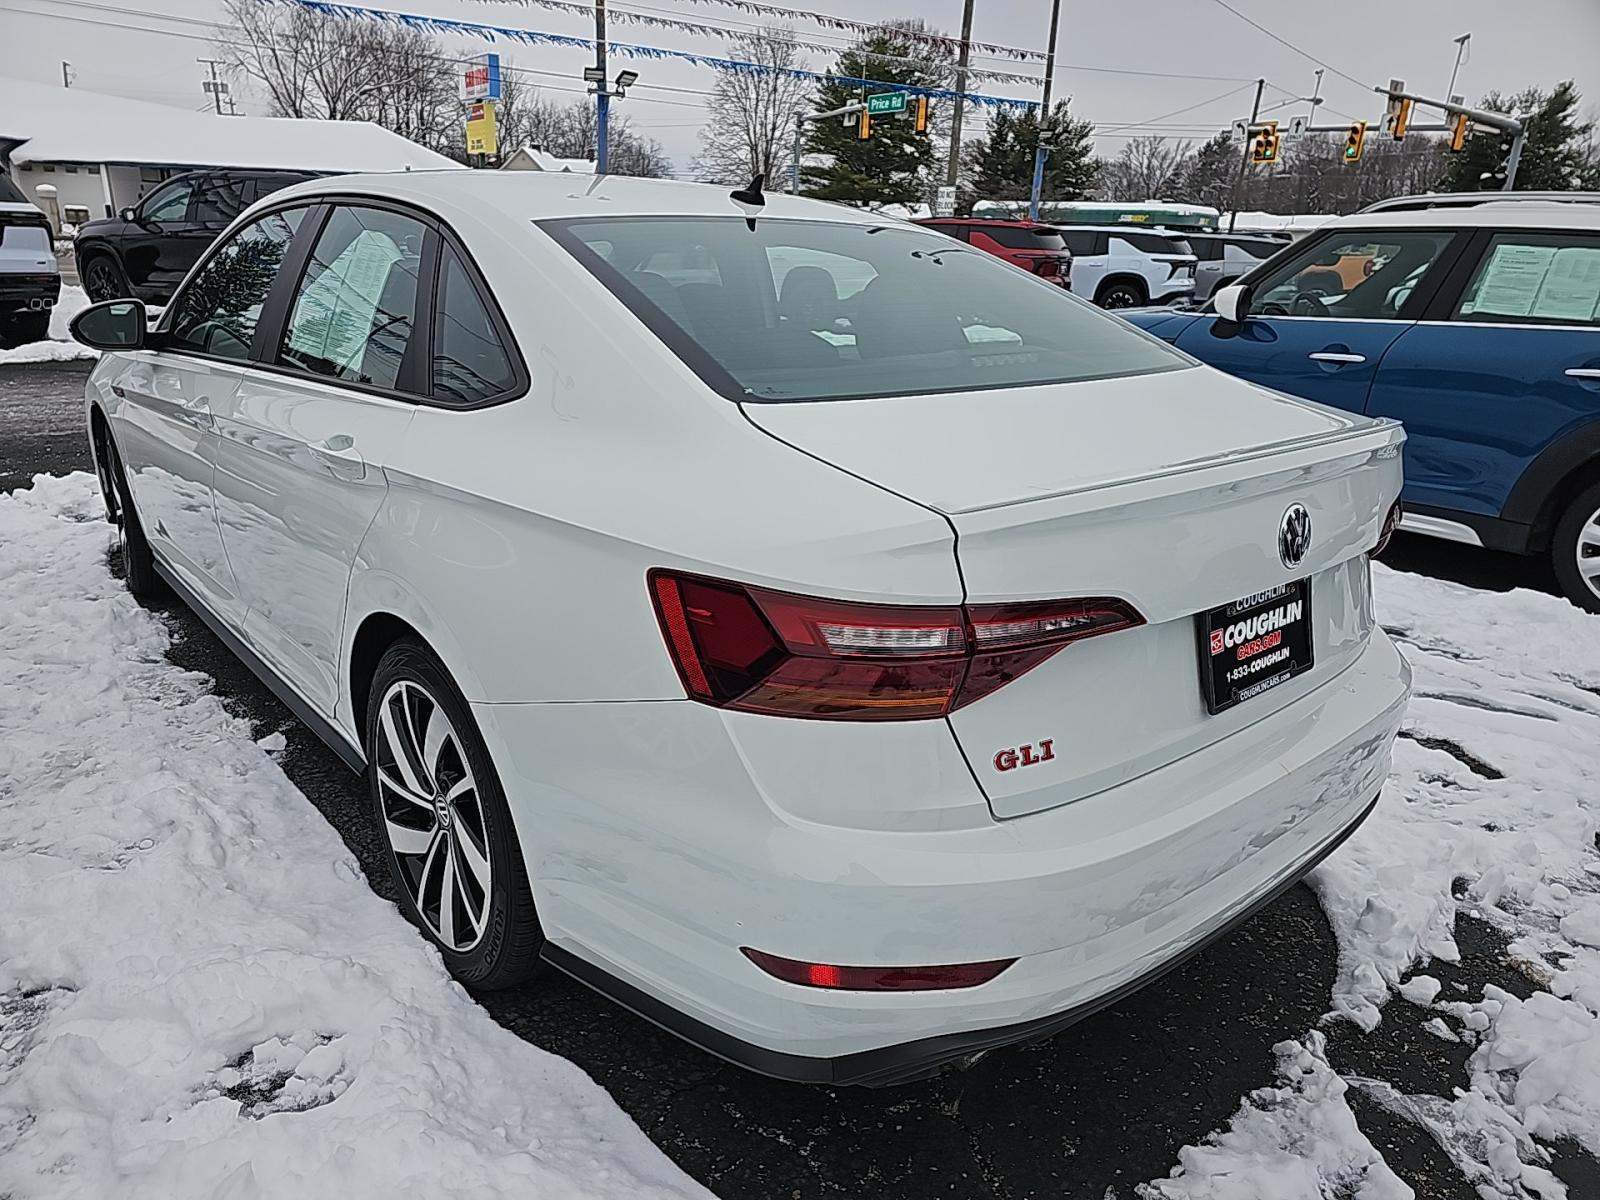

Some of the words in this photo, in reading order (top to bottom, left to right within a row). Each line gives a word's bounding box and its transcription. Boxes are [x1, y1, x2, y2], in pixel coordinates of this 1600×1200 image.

[871, 98, 889, 110] Price
[892, 97, 903, 108] Rd
[1224, 599, 1303, 648] COUGHLIN
[1237, 630, 1282, 661] CARS.COM
[1226, 646, 1290, 683] 1-833-COUGHLIN
[993, 739, 1055, 772] GLI
